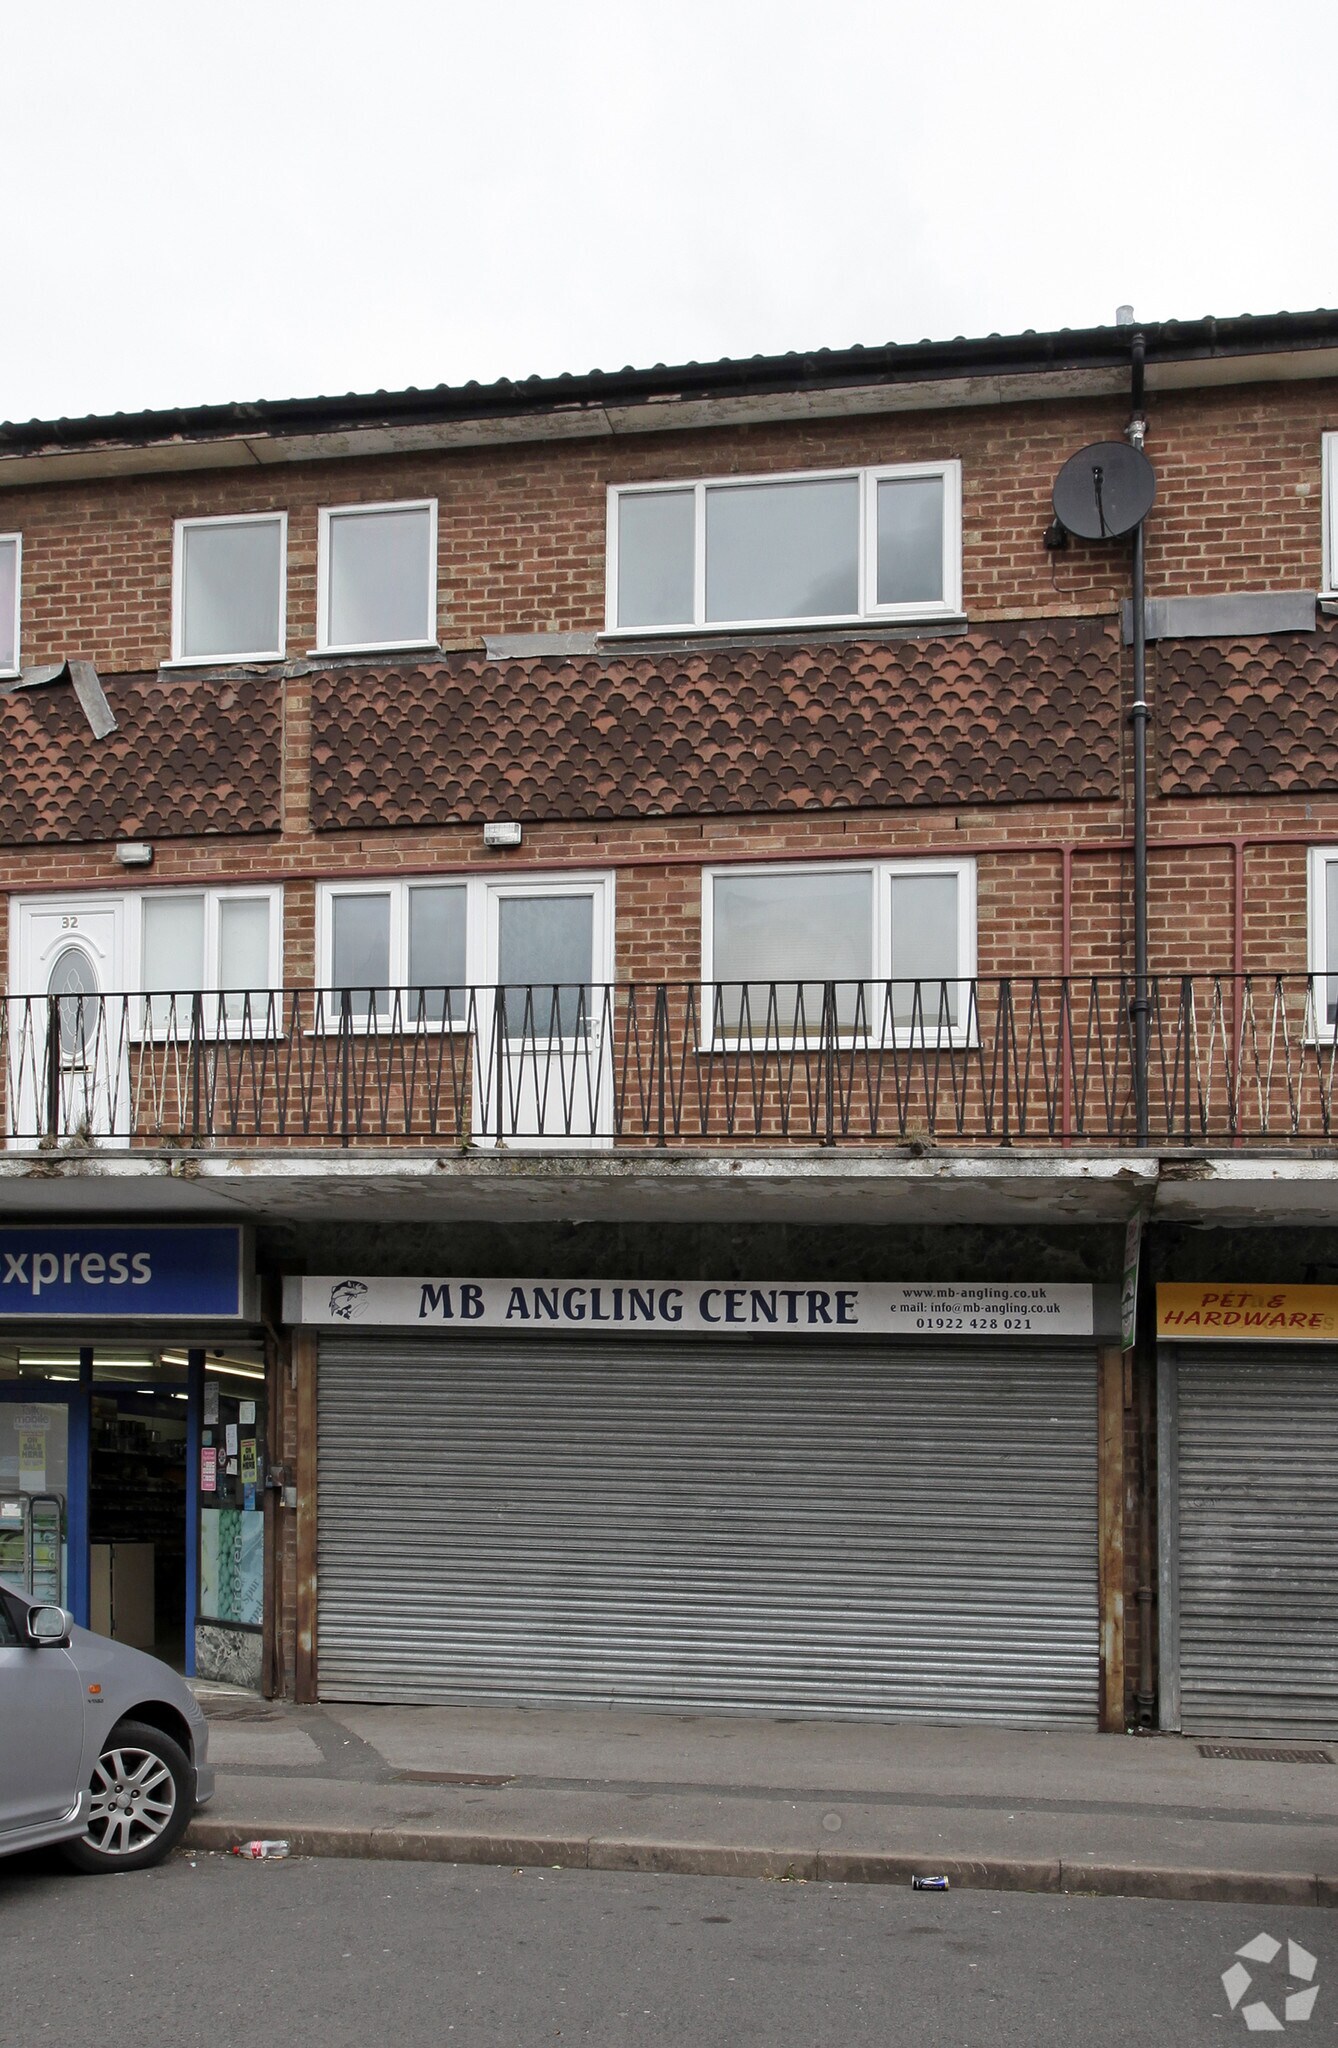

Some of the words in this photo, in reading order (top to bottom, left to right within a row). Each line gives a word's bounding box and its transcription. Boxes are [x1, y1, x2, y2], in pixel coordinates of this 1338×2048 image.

[61, 916, 79, 929] 32
[0, 1252, 152, 1295] xpress
[902, 1287, 1048, 1299] www.mb-angling.co.uk
[1200, 1292, 1253, 1308] PET
[1266, 1294, 1287, 1308] &
[418, 1284, 485, 1319] MB
[505, 1286, 684, 1322] ANGLING
[700, 1288, 859, 1325] CENTRE
[890, 1303, 897, 1313] e
[900, 1302, 927, 1313] mail:
[930, 1302, 1061, 1316] info@mb-angling.co.uk
[916, 1318, 964, 1329] 01922
[969, 1318, 998, 1330] 428
[1004, 1318, 1032, 1330] 021
[1163, 1310, 1325, 1328] HARDWARE
[230, 1535, 243, 1614] Frozen
